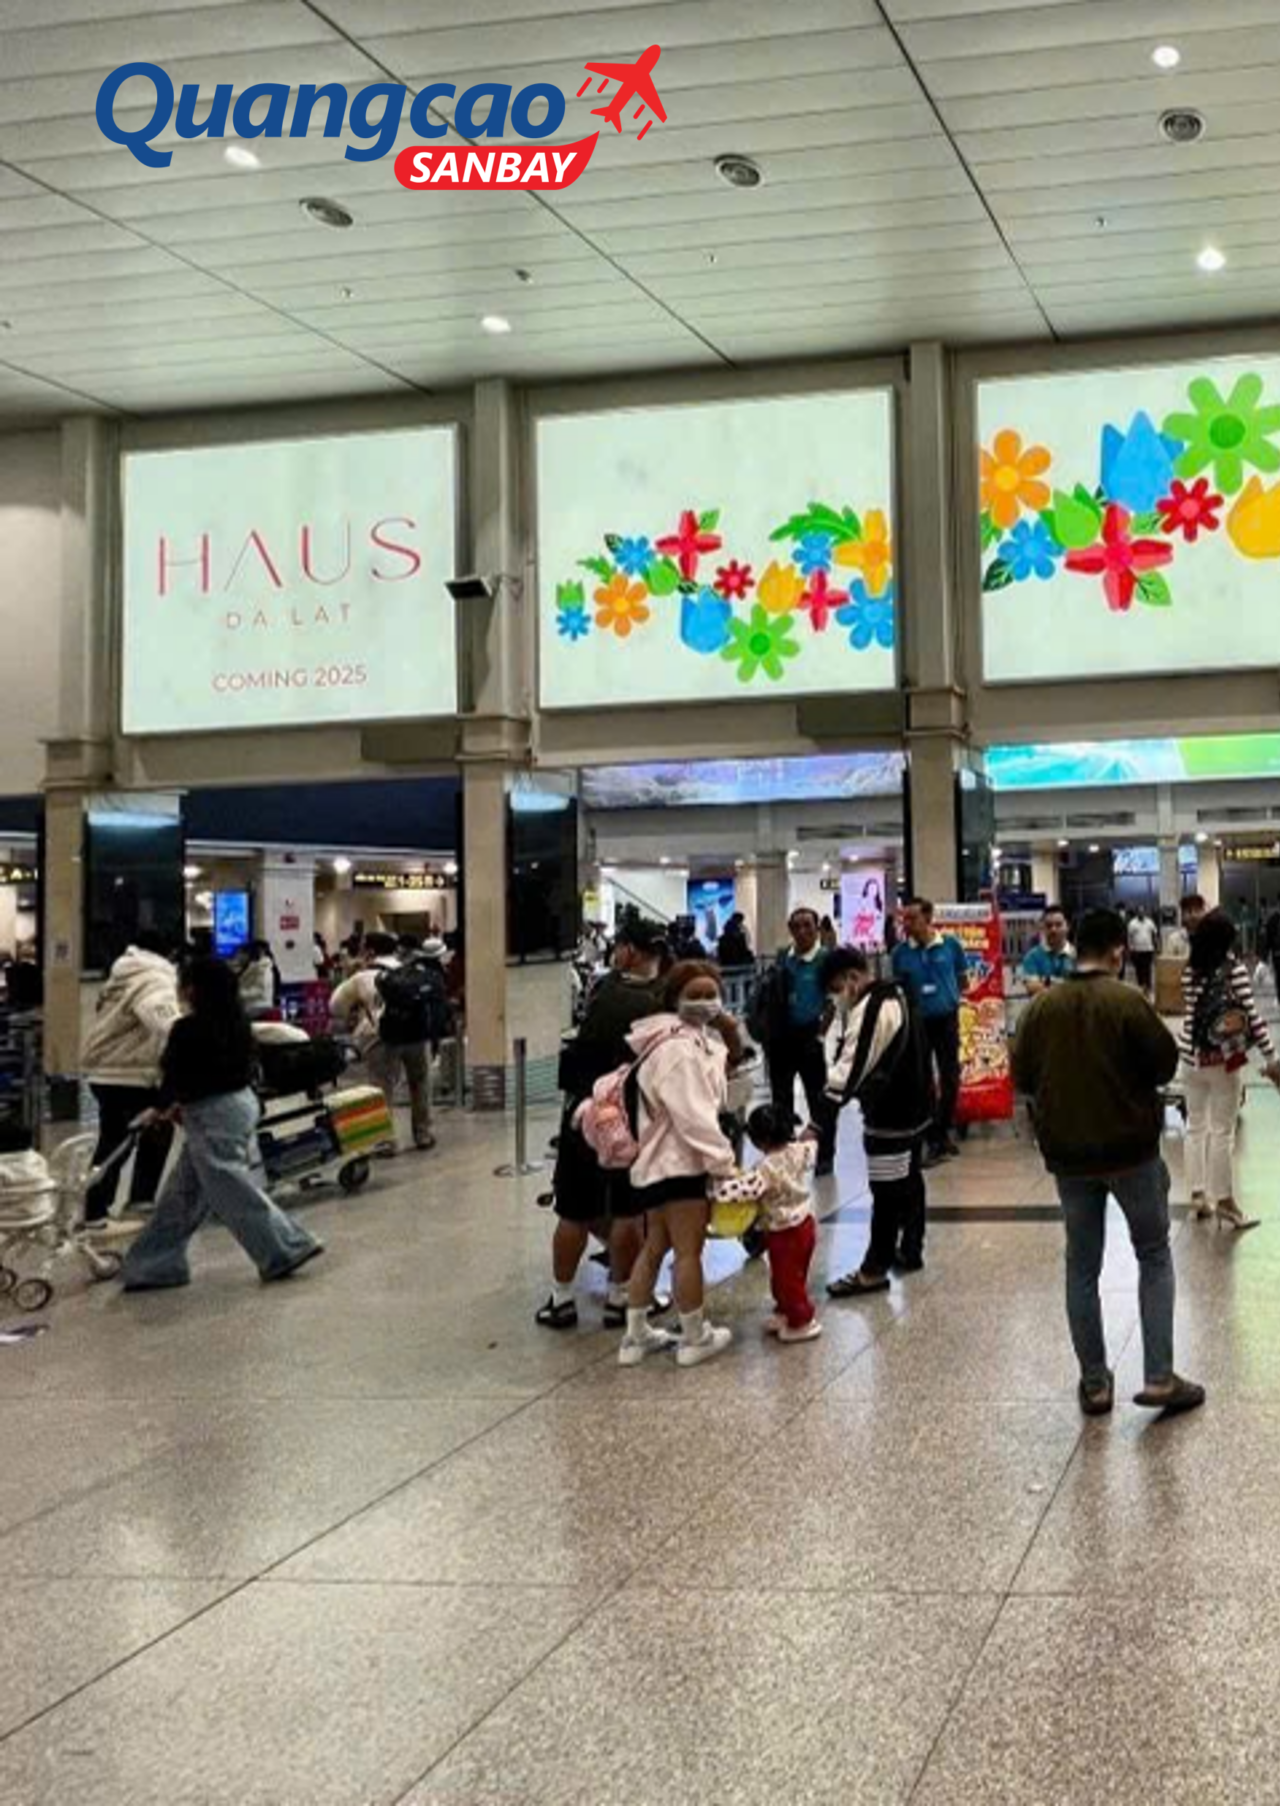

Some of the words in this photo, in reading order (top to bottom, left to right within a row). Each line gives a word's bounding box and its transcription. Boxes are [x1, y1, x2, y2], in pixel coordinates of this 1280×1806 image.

[158, 517, 421, 596] HAUS
[212, 668, 308, 692] COMING
[315, 665, 367, 686] 2025
